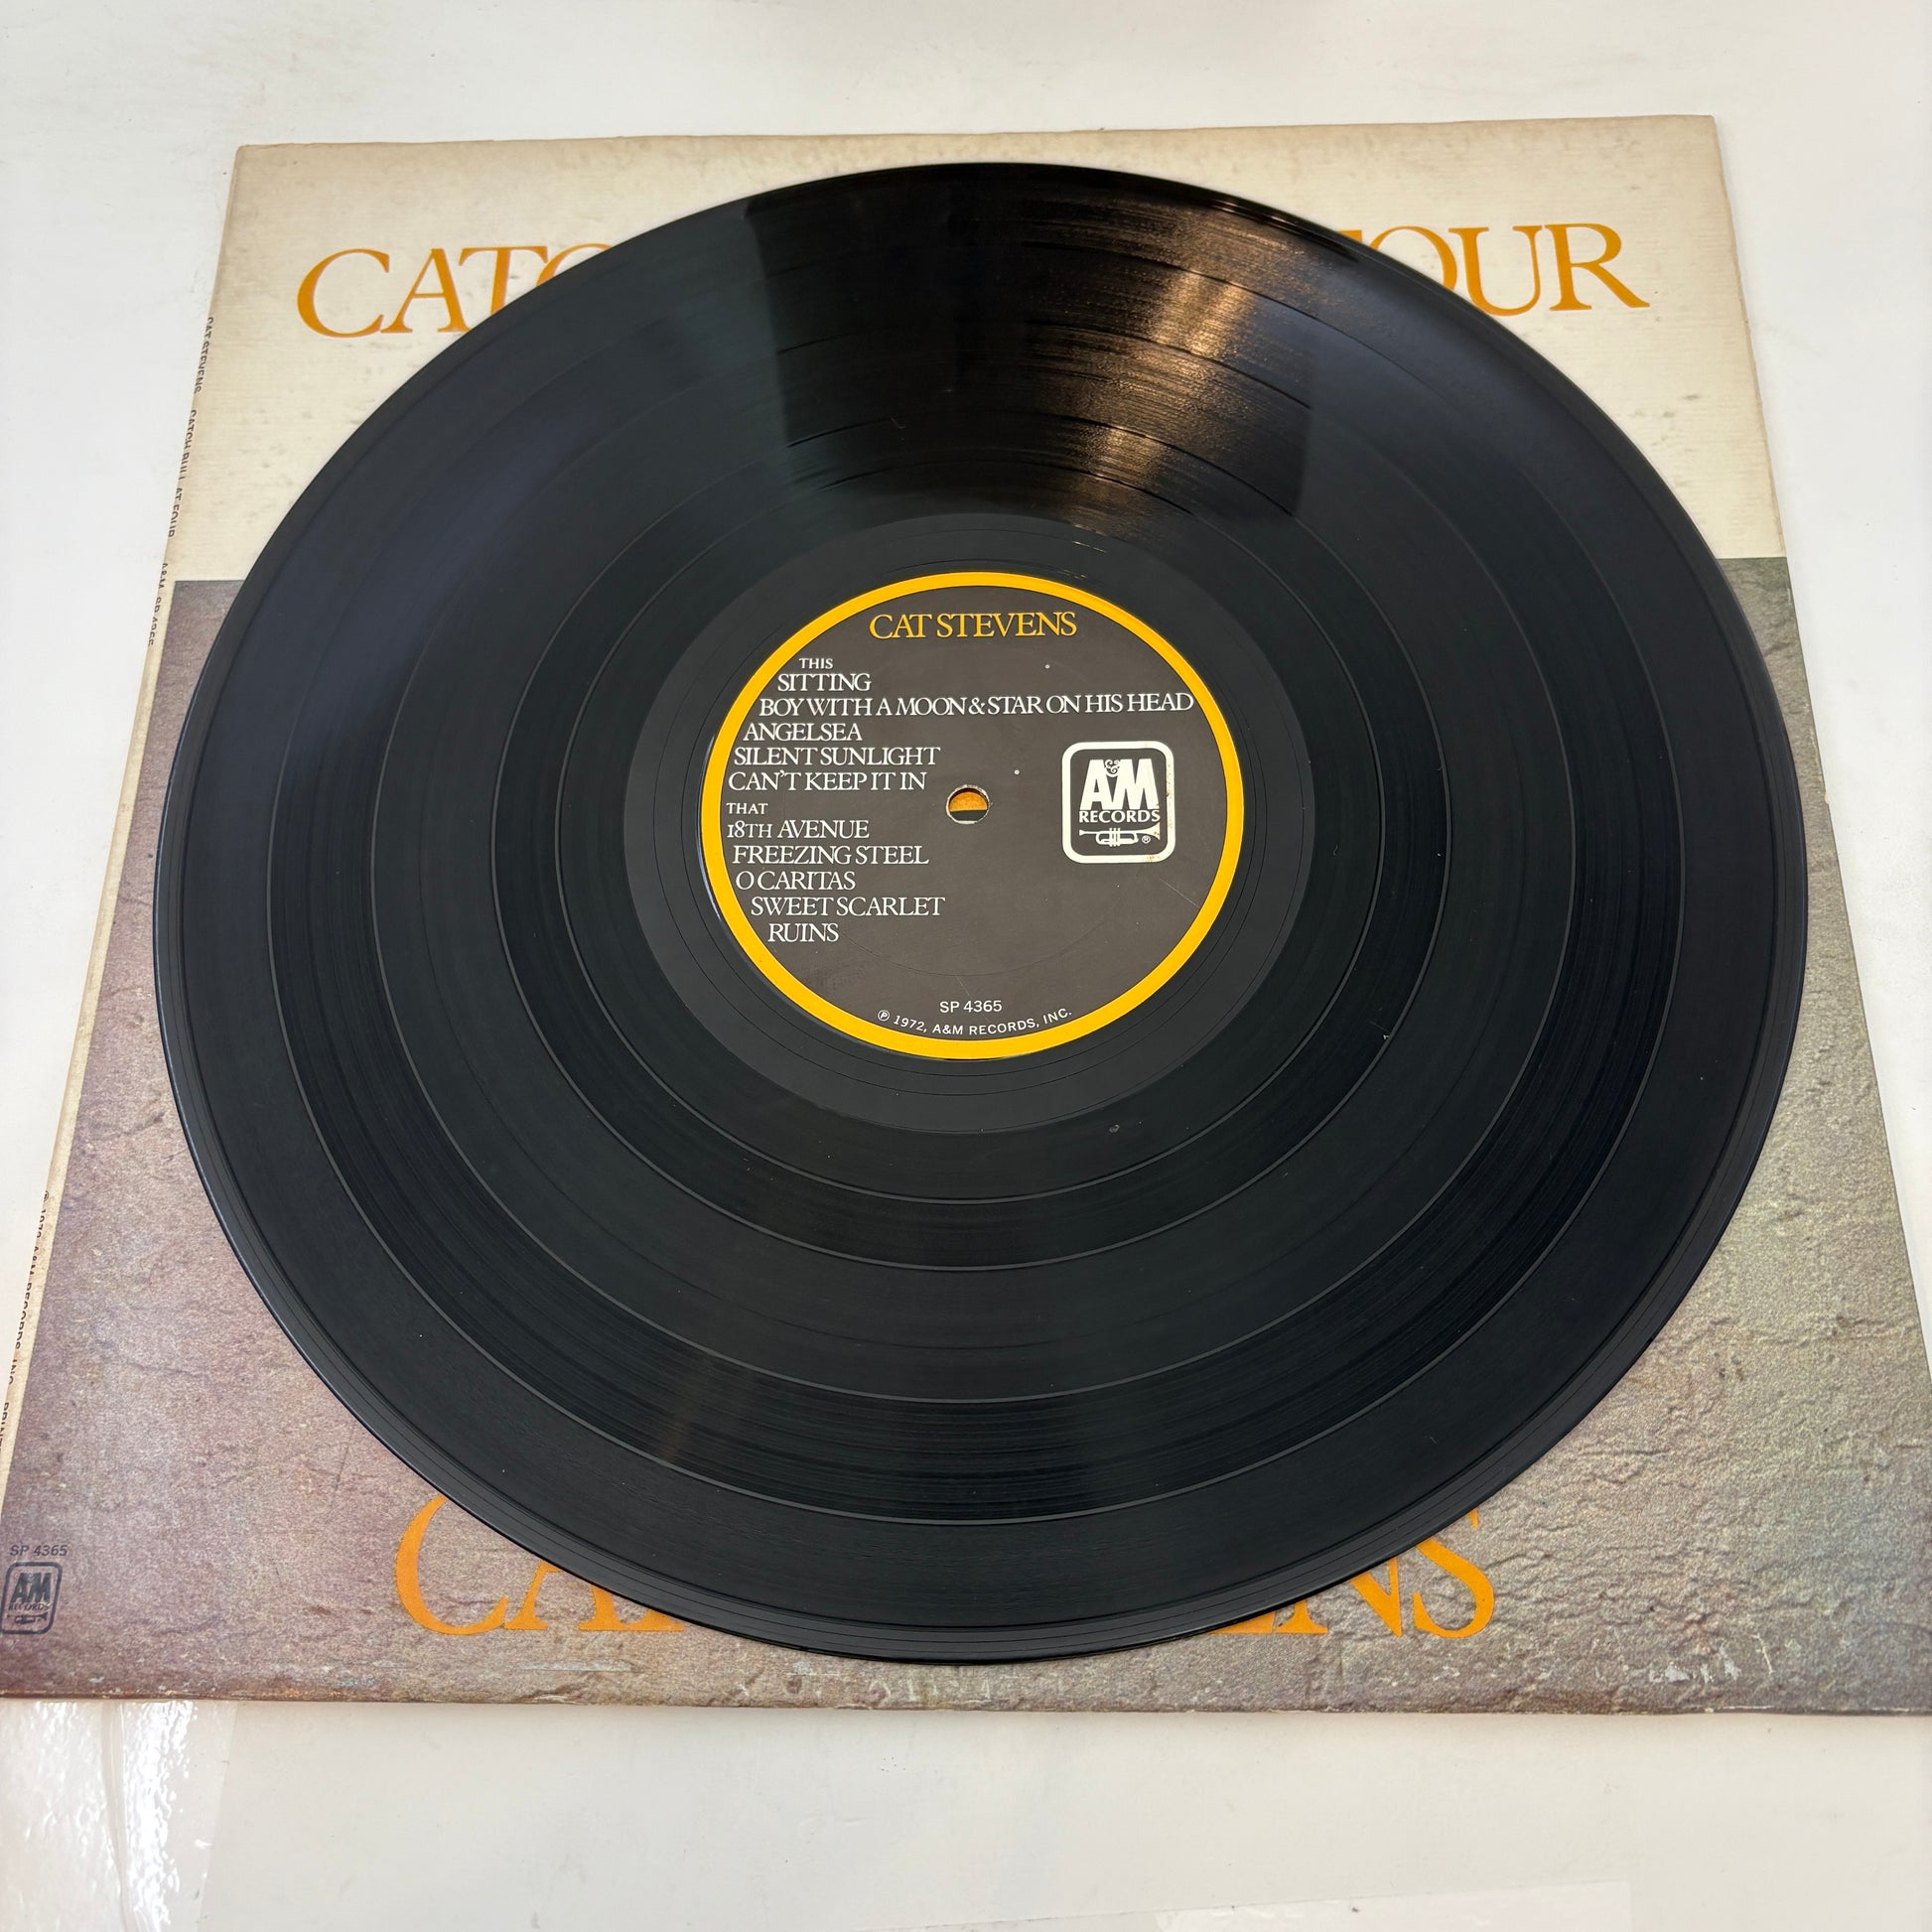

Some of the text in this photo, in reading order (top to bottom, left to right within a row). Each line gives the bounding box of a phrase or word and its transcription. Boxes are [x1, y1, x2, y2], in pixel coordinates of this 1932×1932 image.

[297, 242, 614, 339] CAT
[870, 612, 1076, 638] CAT STEVENS
[799, 658, 833, 669] THIS
[775, 671, 872, 691] SITTING
[759, 691, 1195, 716] BOY WITH A MOON & STAR ON HIS HEAD
[742, 721, 863, 741] ANGELSEA
[734, 747, 941, 765] SILENT SUNLIGHT
[729, 770, 927, 790] CAN'T KEEP IT IN
[726, 803, 768, 814] THAT
[1079, 809, 1161, 823] RECORDS
[727, 820, 870, 839] 18TH AVENUE
[732, 845, 929, 865] FREEZING STEEL
[735, 871, 856, 891] O CARITAS
[752, 897, 945, 916] SWEET SCARLET
[767, 923, 839, 942] RUINS
[940, 1001, 1002, 1013] SP 4365
[894, 1016, 927, 1035] 1972,
[932, 1024, 963, 1035] A&M
[969, 1020, 1039, 1035] RECORDS,
[1043, 1009, 1072, 1024] INC.
[10, 1545, 69, 1557] SP 4365
